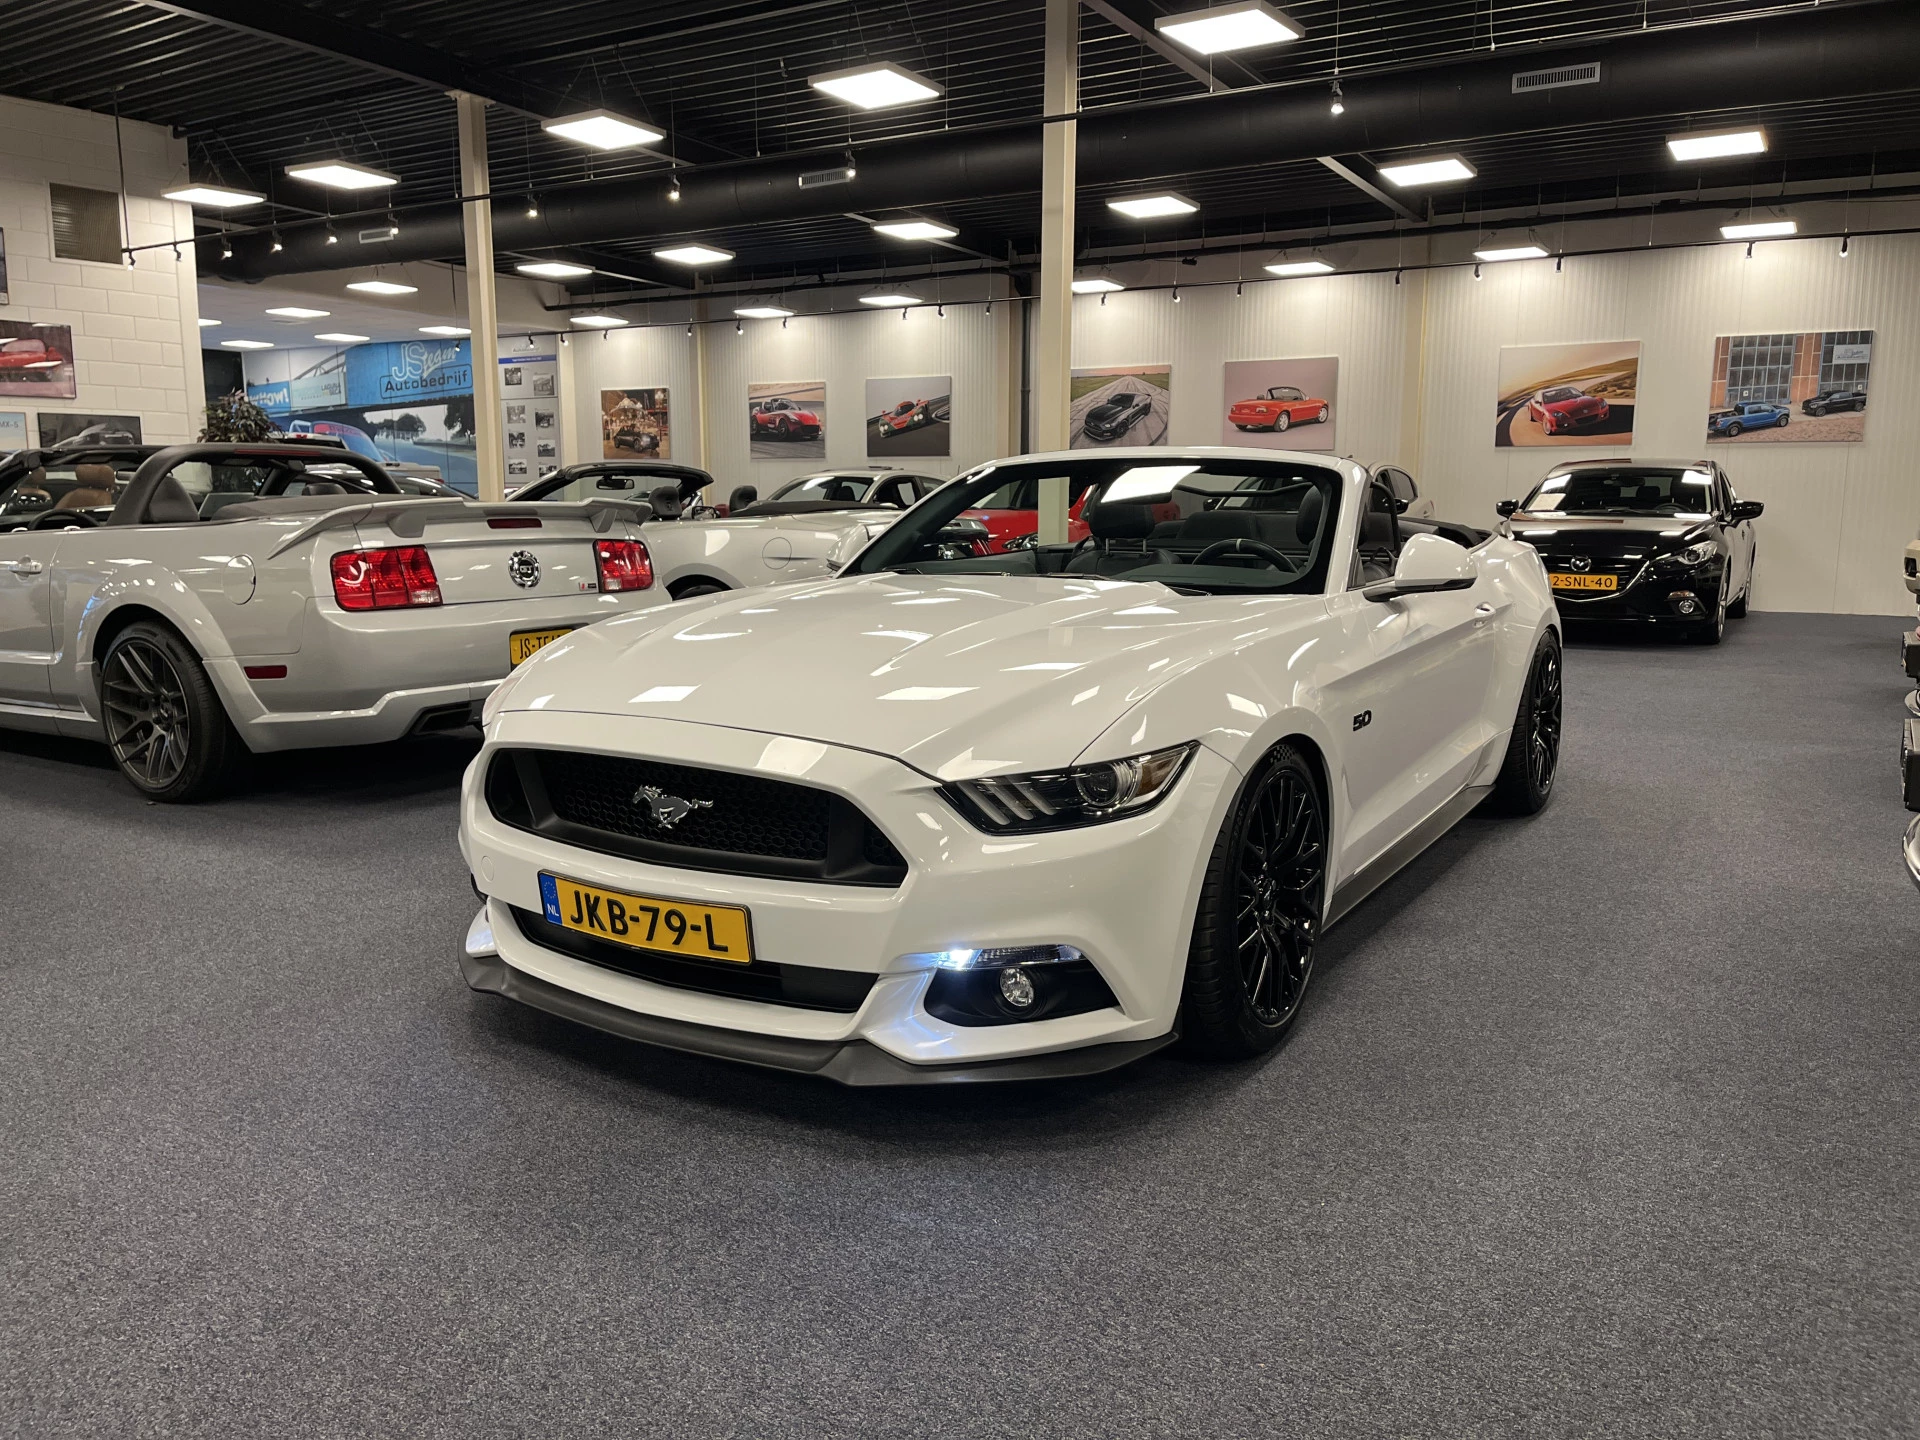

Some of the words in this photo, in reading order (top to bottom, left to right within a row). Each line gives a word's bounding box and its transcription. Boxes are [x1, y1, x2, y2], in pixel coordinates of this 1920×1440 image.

[384, 369, 468, 393] Autobedrijf
[547, 903, 560, 917] NL
[570, 890, 729, 953] JKB-79-L
